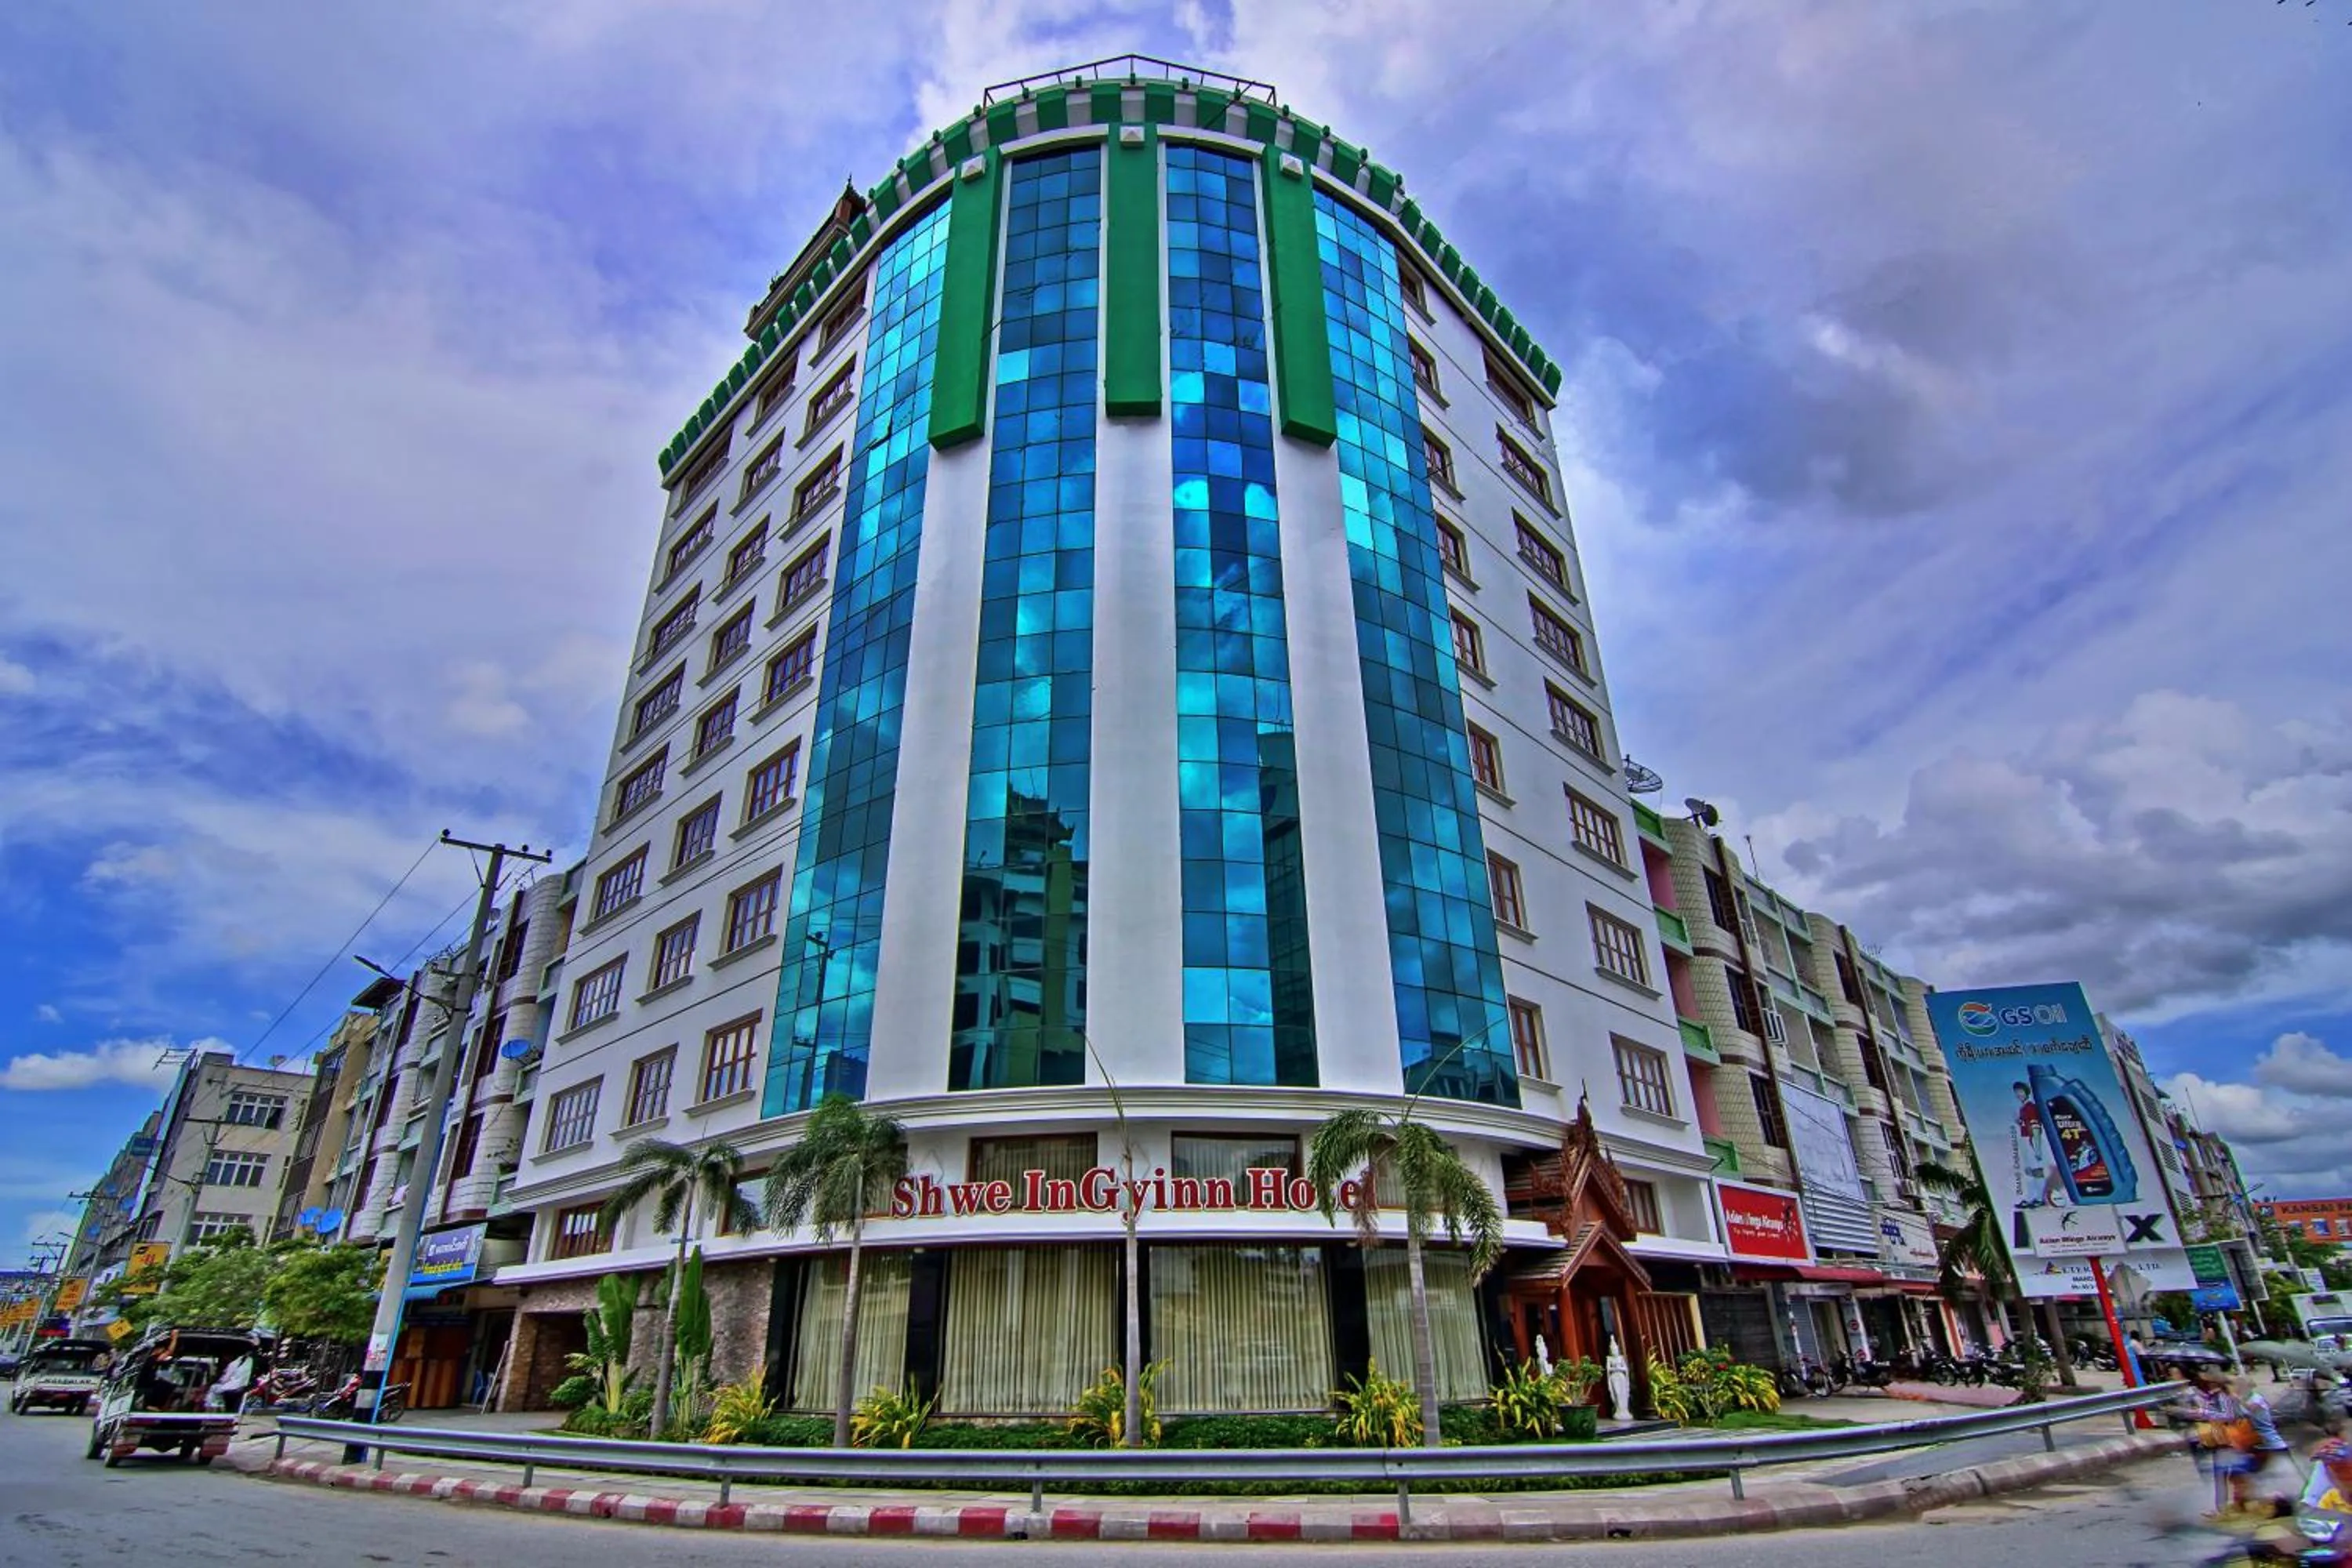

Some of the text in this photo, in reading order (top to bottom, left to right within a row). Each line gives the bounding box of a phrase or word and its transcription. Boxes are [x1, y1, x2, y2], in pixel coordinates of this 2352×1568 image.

[2000, 1006, 2034, 1025] GS
[2061, 1129, 2080, 1140] 4T
[891, 1167, 1377, 1225] Shwe InGyinn Hoel
